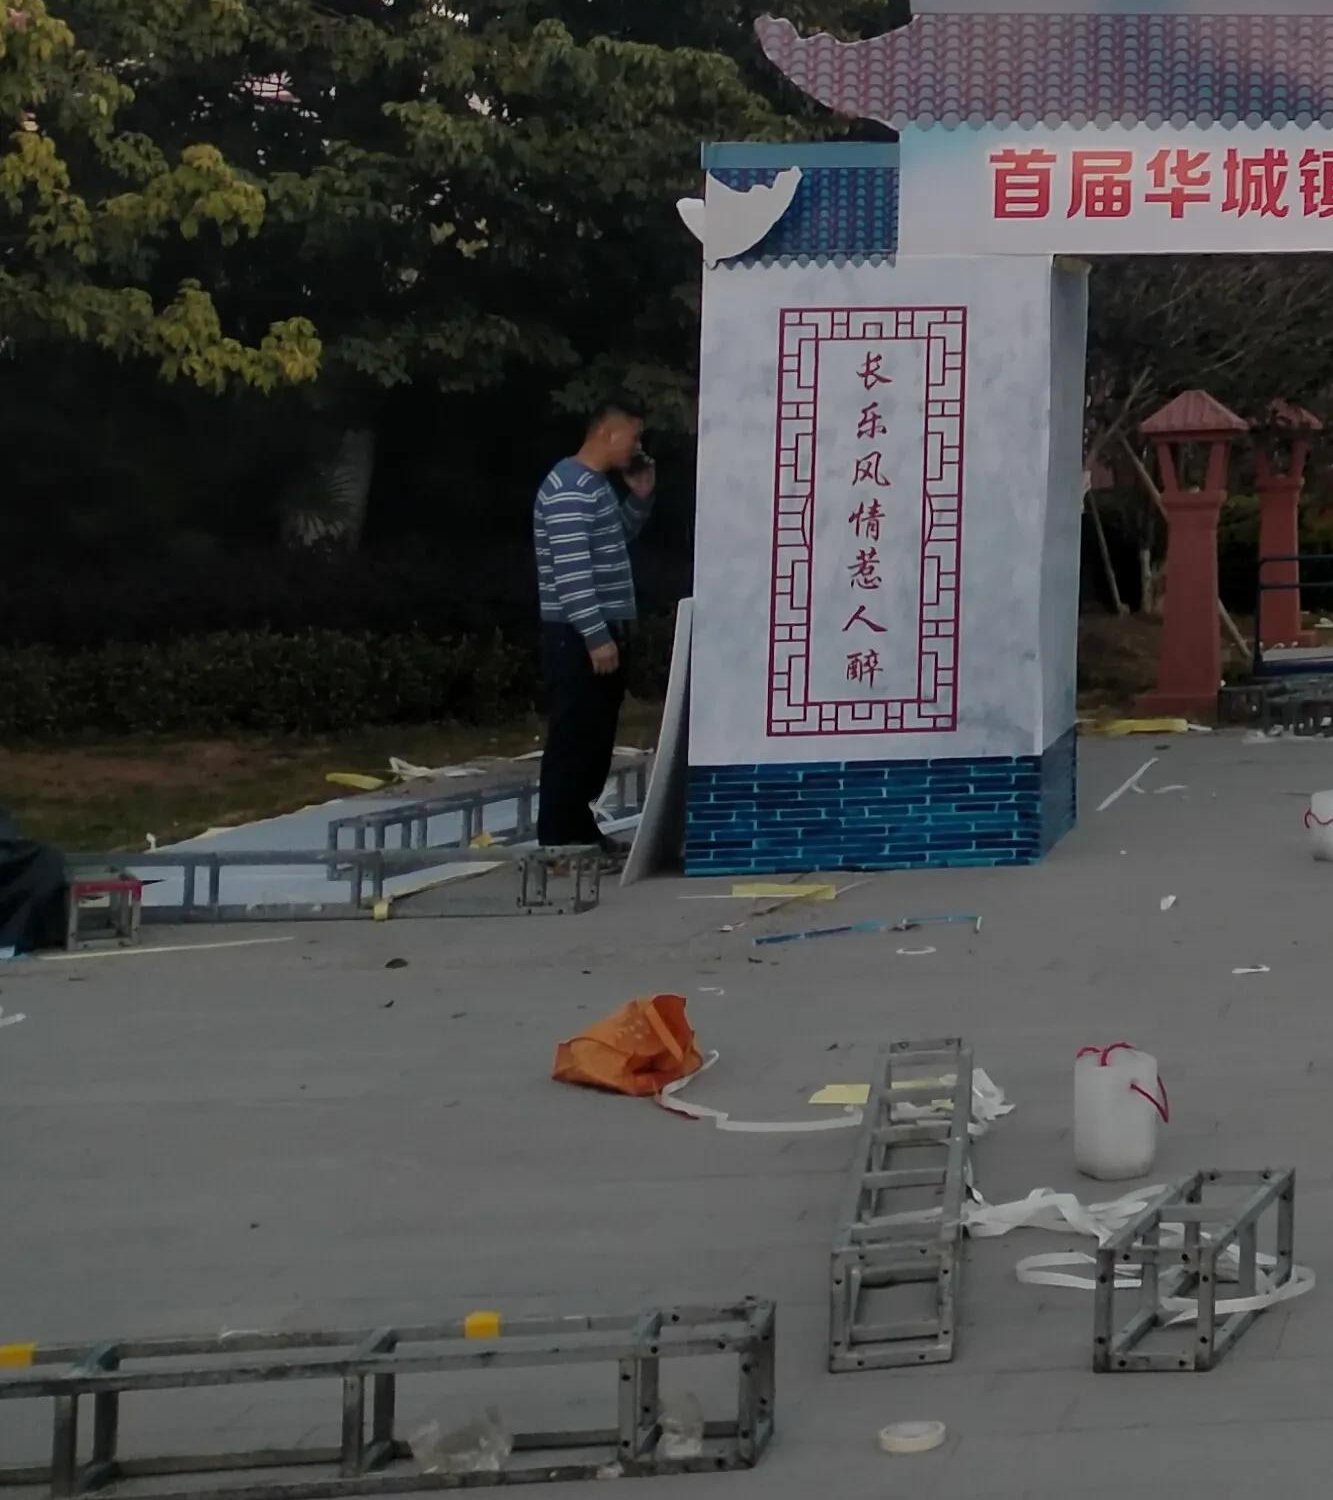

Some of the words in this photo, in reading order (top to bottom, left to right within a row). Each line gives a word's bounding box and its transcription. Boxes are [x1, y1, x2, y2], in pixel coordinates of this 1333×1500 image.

[842, 350, 893, 689] 长乐风情惹人醉
